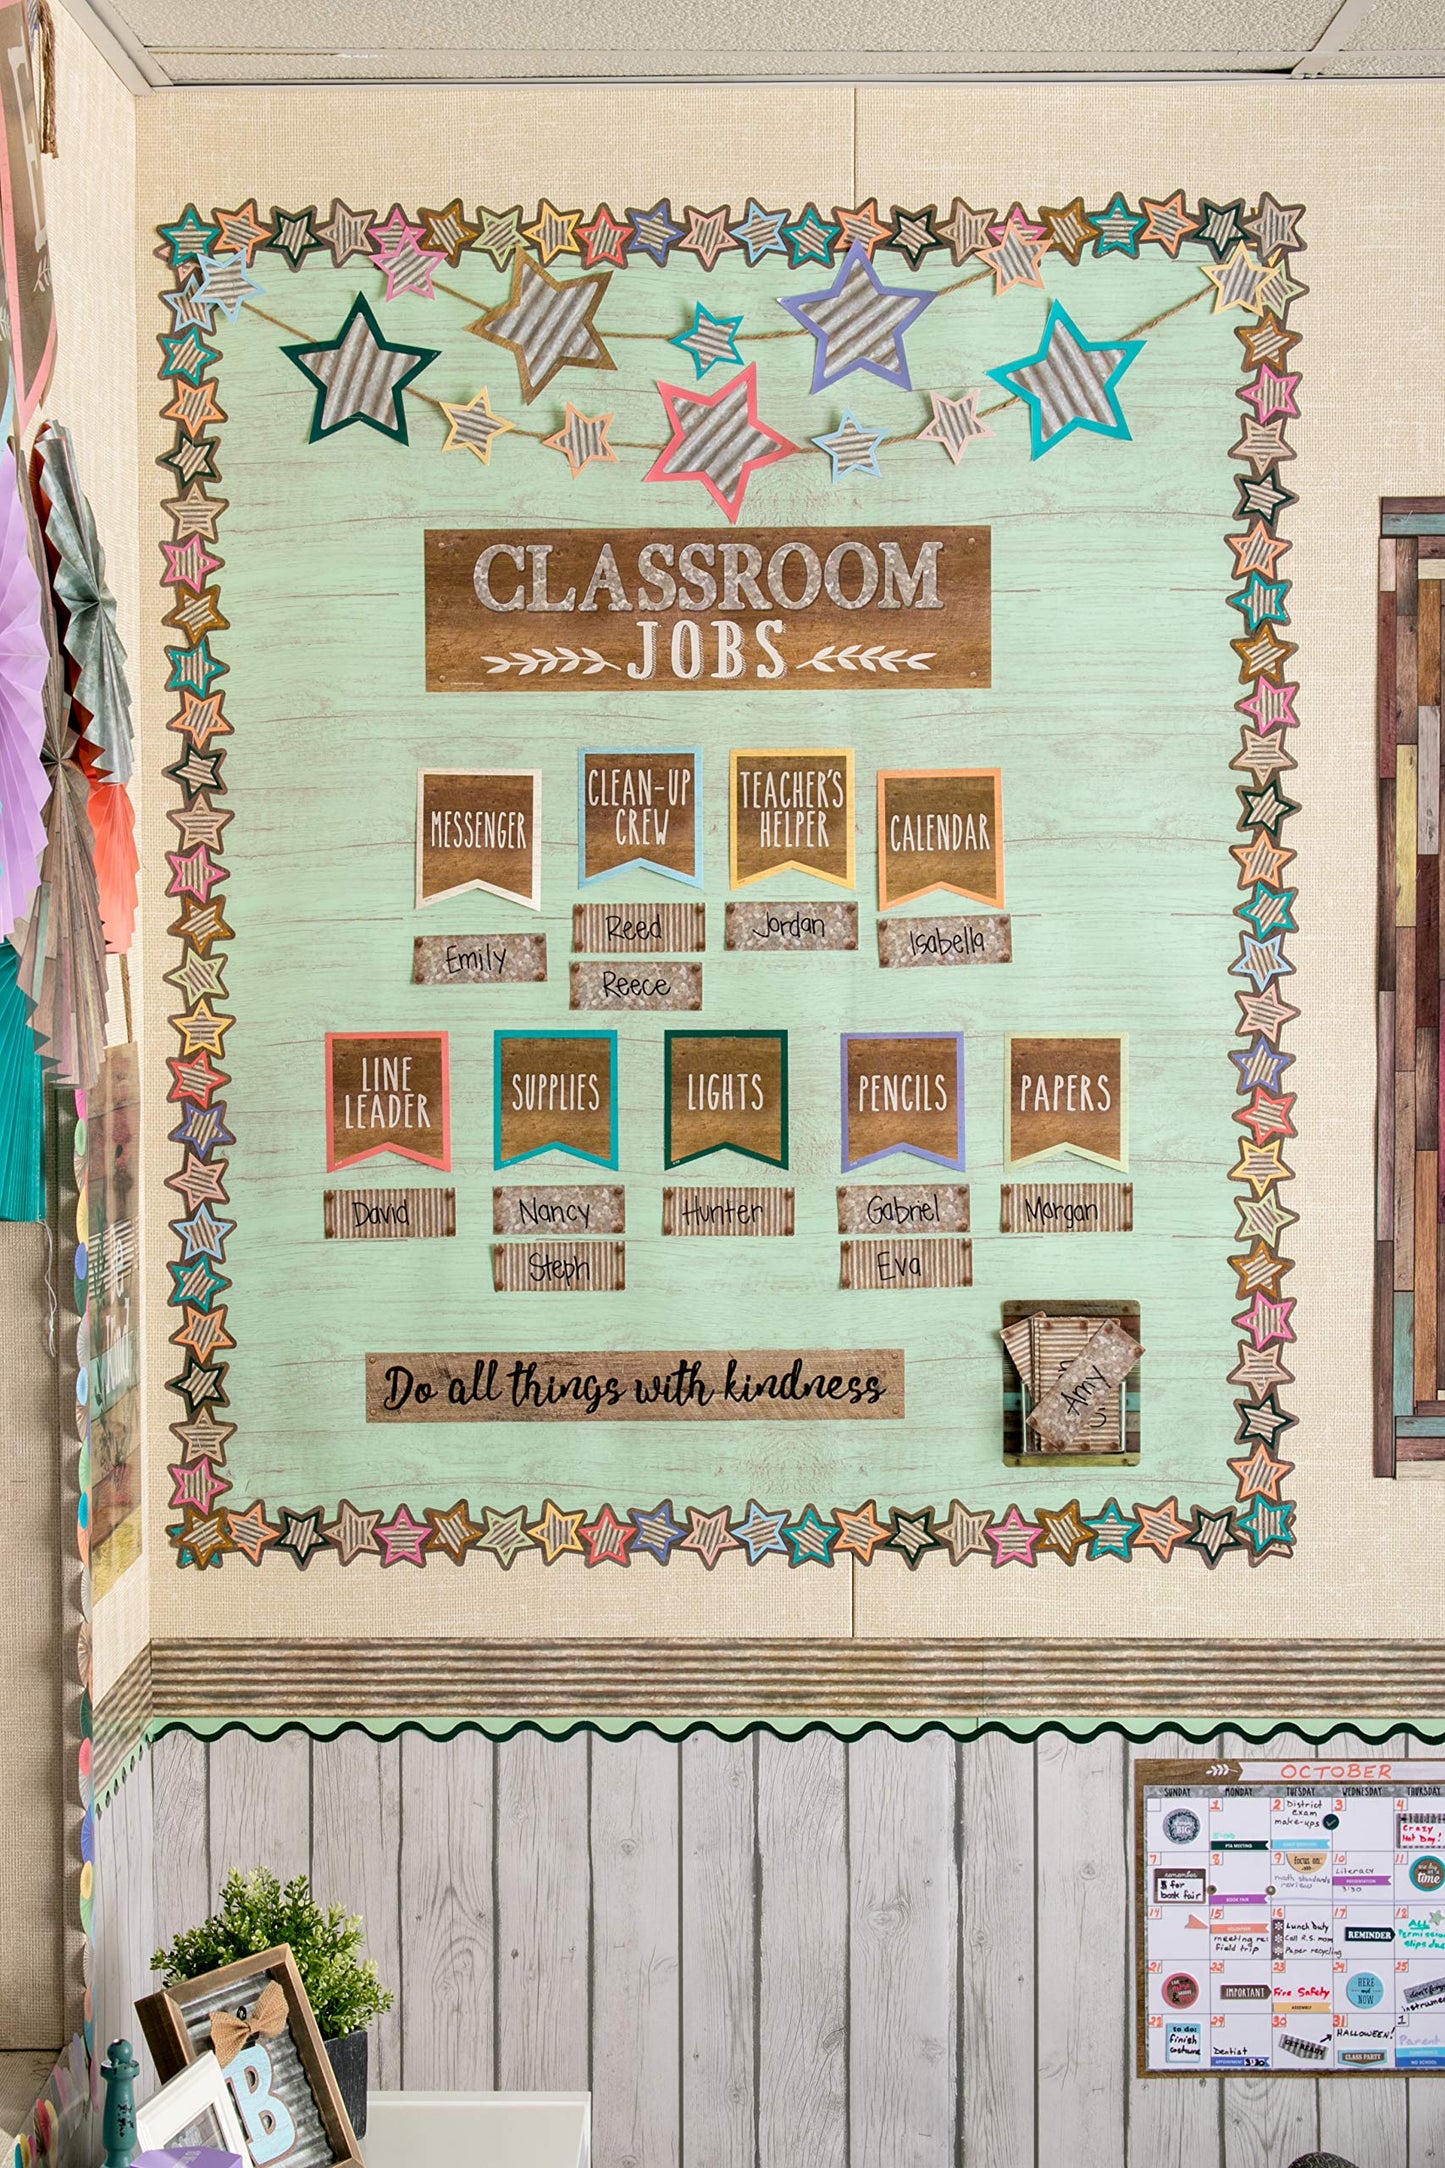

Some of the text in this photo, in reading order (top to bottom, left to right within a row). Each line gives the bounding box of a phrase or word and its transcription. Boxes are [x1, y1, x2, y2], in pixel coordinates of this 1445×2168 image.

[472, 541, 945, 612] CLASSROOM
[627, 619, 786, 681] JOBS
[588, 768, 691, 807] CLEAN-UP
[740, 770, 844, 809] TEACHER'S
[431, 811, 527, 850] MESSENGER
[615, 809, 669, 846] CREW
[760, 811, 830, 848] HELPER
[890, 814, 991, 852] CALENDAR
[606, 915, 663, 941] Reed
[752, 911, 826, 938] Jordan
[909, 926, 986, 956] Isabella
[446, 944, 507, 974] Emily
[602, 972, 672, 999] Reece
[362, 1056, 413, 1092] LINE
[512, 1073, 600, 1111] SUPPLIES
[688, 1073, 764, 1111] LIGHTS
[858, 1073, 948, 1112] PENCILS
[1020, 1074, 1111, 1112] PAPERS
[345, 1093, 431, 1129] LEADER
[352, 1199, 409, 1228] David
[519, 1197, 590, 1229] Nancy
[682, 1196, 763, 1226] Hunter
[867, 1194, 940, 1225] Gabriel
[1025, 1196, 1098, 1229] Morgan
[529, 1252, 591, 1287] Steph
[877, 1251, 921, 1281] Eva
[384, 1358, 886, 1414] Do all things with kindness
[1060, 1365, 1112, 1416] Amy
[1280, 1764, 1392, 1780] OCTOBER
[1164, 1787, 1441, 1797] SUNDAY MONDAY TUESDAY WEDNESDAY THURSDAY
[1210, 1798, 1405, 1812] 1 2 3 4
[1286, 1800, 1323, 1809] District
[1274, 1817, 1321, 1830] make-ups
[1402, 1824, 1434, 1835] Crazy
[1149, 1854, 1157, 1864] 7
[1212, 1854, 1220, 1865] 8
[1274, 1852, 1282, 1864] 9
[1334, 1853, 1346, 1864] 10
[1293, 1855, 1311, 1866] focus
[1164, 1870, 1198, 1879] remember
[1335, 1867, 1375, 1875] Literacy
[1418, 1873, 1441, 1884] time
[1169, 1880, 1185, 1889] for
[1160, 1890, 1201, 1901] book fair
[1149, 1907, 1161, 1918] 14
[1210, 1908, 1223, 1920] 15
[1272, 1908, 1284, 1919] 16
[1334, 1908, 1346, 1918] 17
[1286, 1922, 1310, 1931] Lunch
[1213, 1935, 1253, 1947] meeting
[1348, 1930, 1392, 1940] REMINDER
[1240, 1945, 1260, 1955] trip
[1285, 1946, 1342, 1959] Paper recycling
[1148, 1961, 1161, 1972] 21
[1209, 1961, 1224, 1972] 22
[1273, 1961, 1286, 1972] 23
[1395, 1961, 1409, 1971] 25
[1357, 1977, 1375, 1987] HERE
[1225, 1987, 1265, 1998] IMPORTANT
[1273, 1986, 1330, 2000] Fire Safety
[1357, 1994, 1374, 2005] NOW
[1210, 2016, 1225, 2026] 29
[1272, 2015, 1287, 2028] 30
[1332, 2014, 1345, 2028] 31
[1397, 2016, 1406, 2025] 1
[1336, 2026, 1396, 2040] HALLOWEEN!
[1399, 2034, 1440, 2046] Parent
[1169, 2046, 1201, 2056] costume
[1213, 2047, 1248, 2056] Dentist
[1300, 2043, 1325, 2056] READY
[1345, 2053, 1382, 2061] CLASS PARTY
[222, 2040, 298, 2168] B
